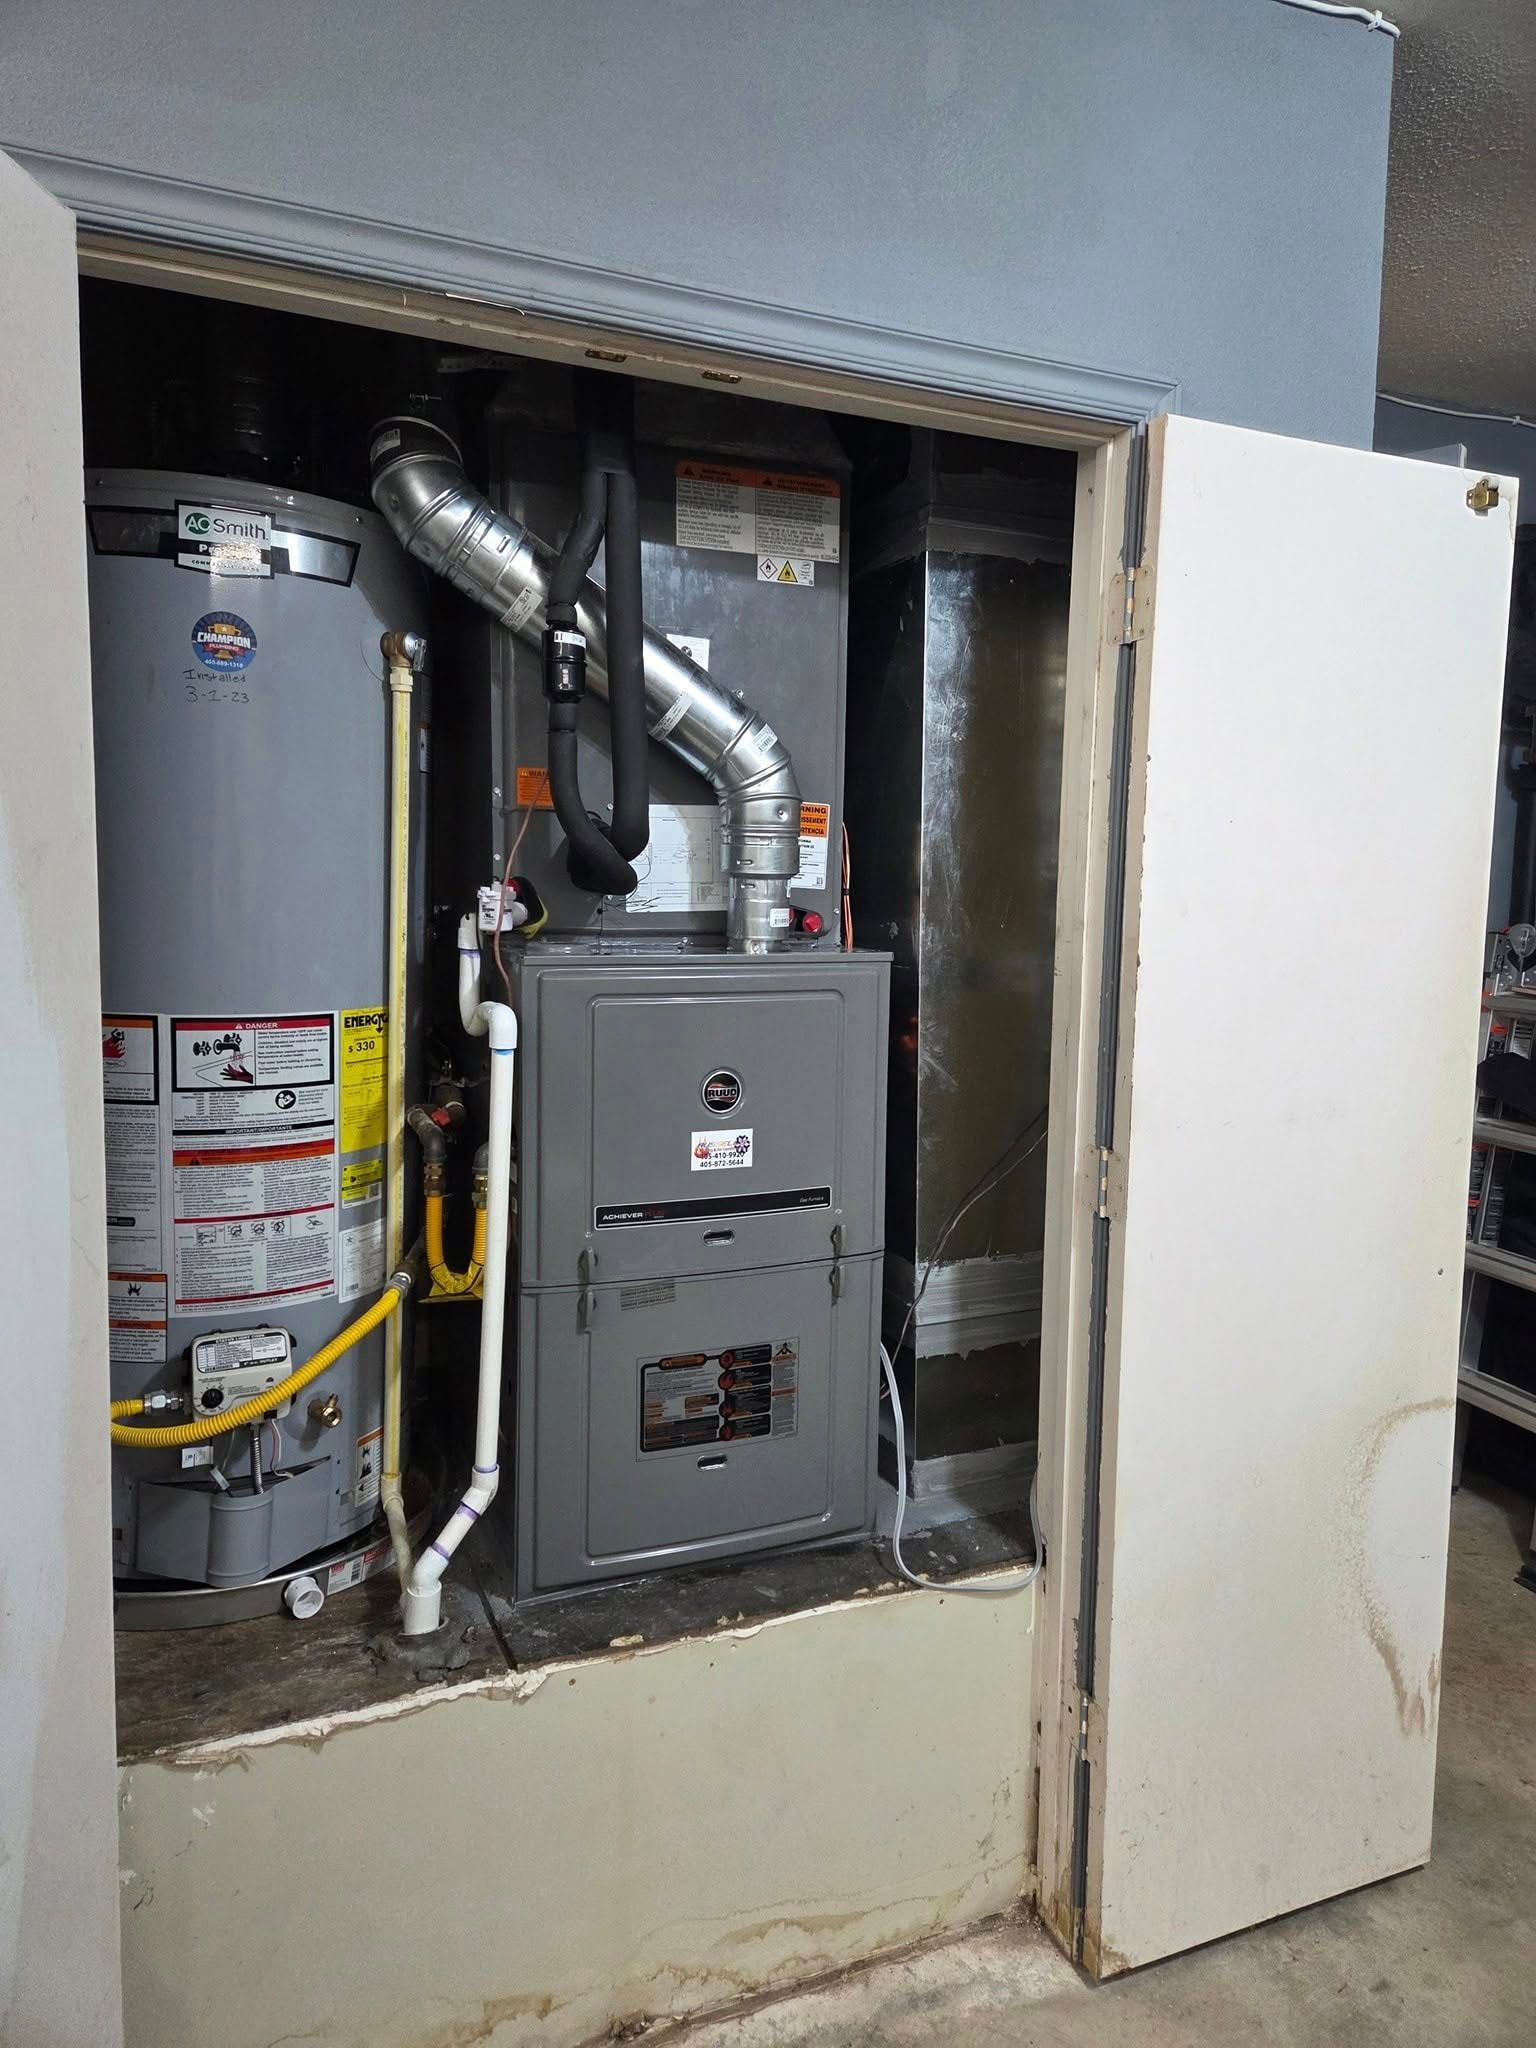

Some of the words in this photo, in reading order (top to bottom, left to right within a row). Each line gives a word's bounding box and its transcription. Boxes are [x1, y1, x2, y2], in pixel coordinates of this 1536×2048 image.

[213, 518, 266, 540] Smith
[197, 632, 251, 649] CHAMPION
[182, 669, 247, 682] Installed
[185, 686, 250, 703] 3-1-23
[245, 1022, 278, 1030] DANGER
[356, 1041, 375, 1052] 330
[708, 1088, 737, 1098] RUUD
[602, 1212, 643, 1221] ACHIEVER
